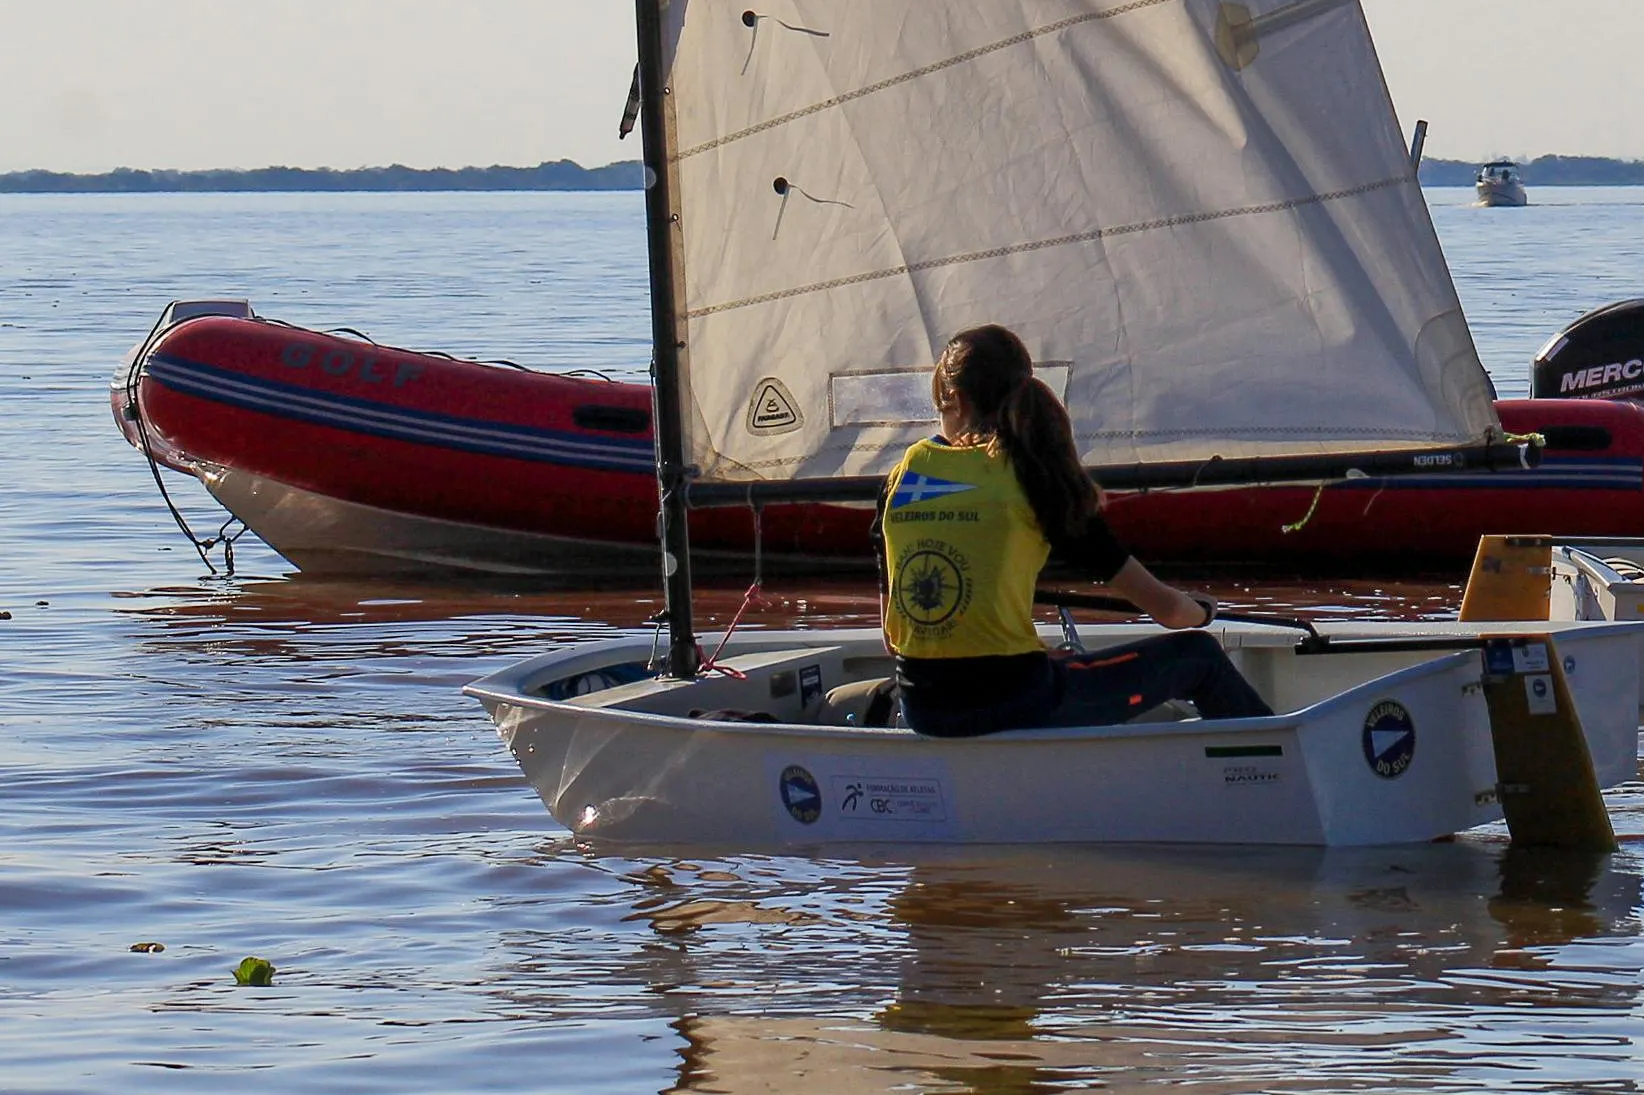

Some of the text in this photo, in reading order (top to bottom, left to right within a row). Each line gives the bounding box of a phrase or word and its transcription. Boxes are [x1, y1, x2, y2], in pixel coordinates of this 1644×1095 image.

[938, 511, 955, 523] DO
[957, 511, 980, 523] SUL
[1377, 759, 1390, 775] DO
